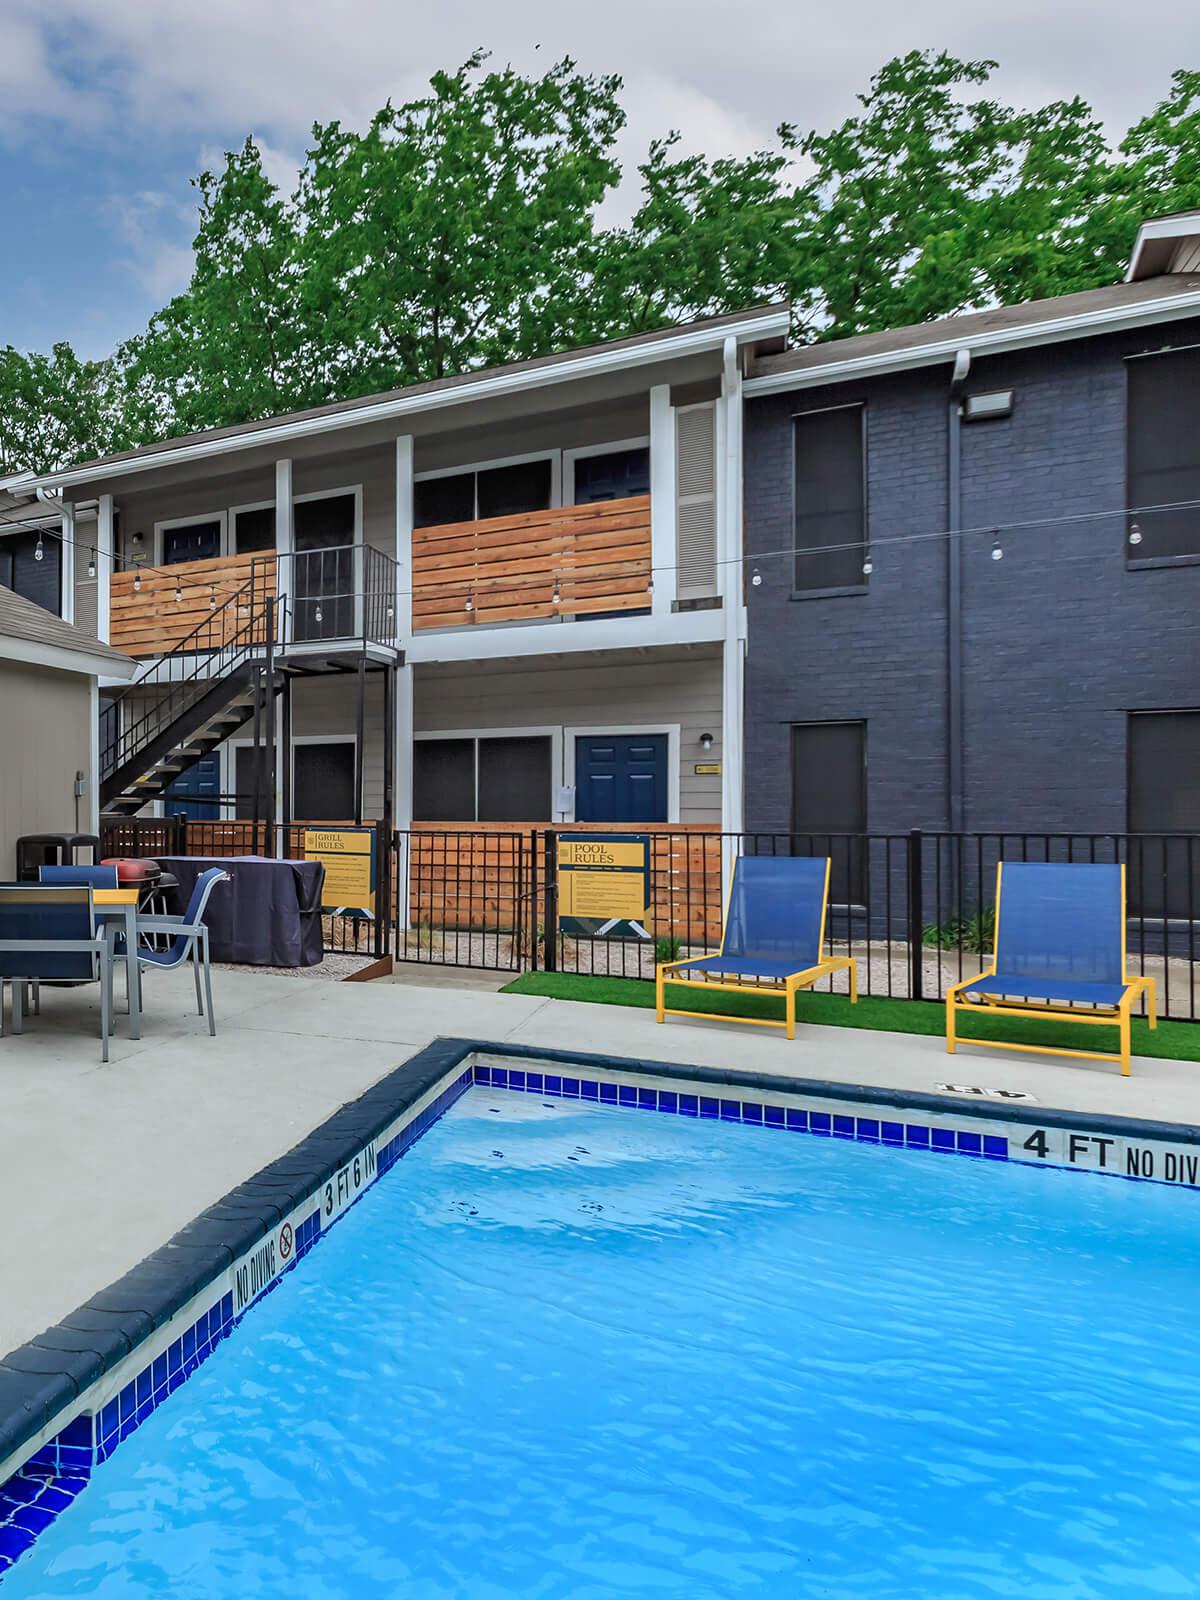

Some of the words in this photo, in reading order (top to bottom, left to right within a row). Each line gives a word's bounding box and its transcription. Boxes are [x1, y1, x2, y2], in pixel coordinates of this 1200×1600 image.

[575, 844, 607, 853] POOL
[575, 854, 614, 863] RULES
[326, 1184, 333, 1216] 3
[338, 1168, 349, 1206] FT
[354, 1158, 361, 1188] 6
[365, 1143, 375, 1178] IN
[1024, 1130, 1049, 1158] 4
[1069, 1134, 1114, 1167] FT
[1127, 1147, 1153, 1178] NO
[1165, 1153, 1197, 1185] DIV
[237, 1264, 248, 1309] NO
[251, 1240, 275, 1294] DIVING
